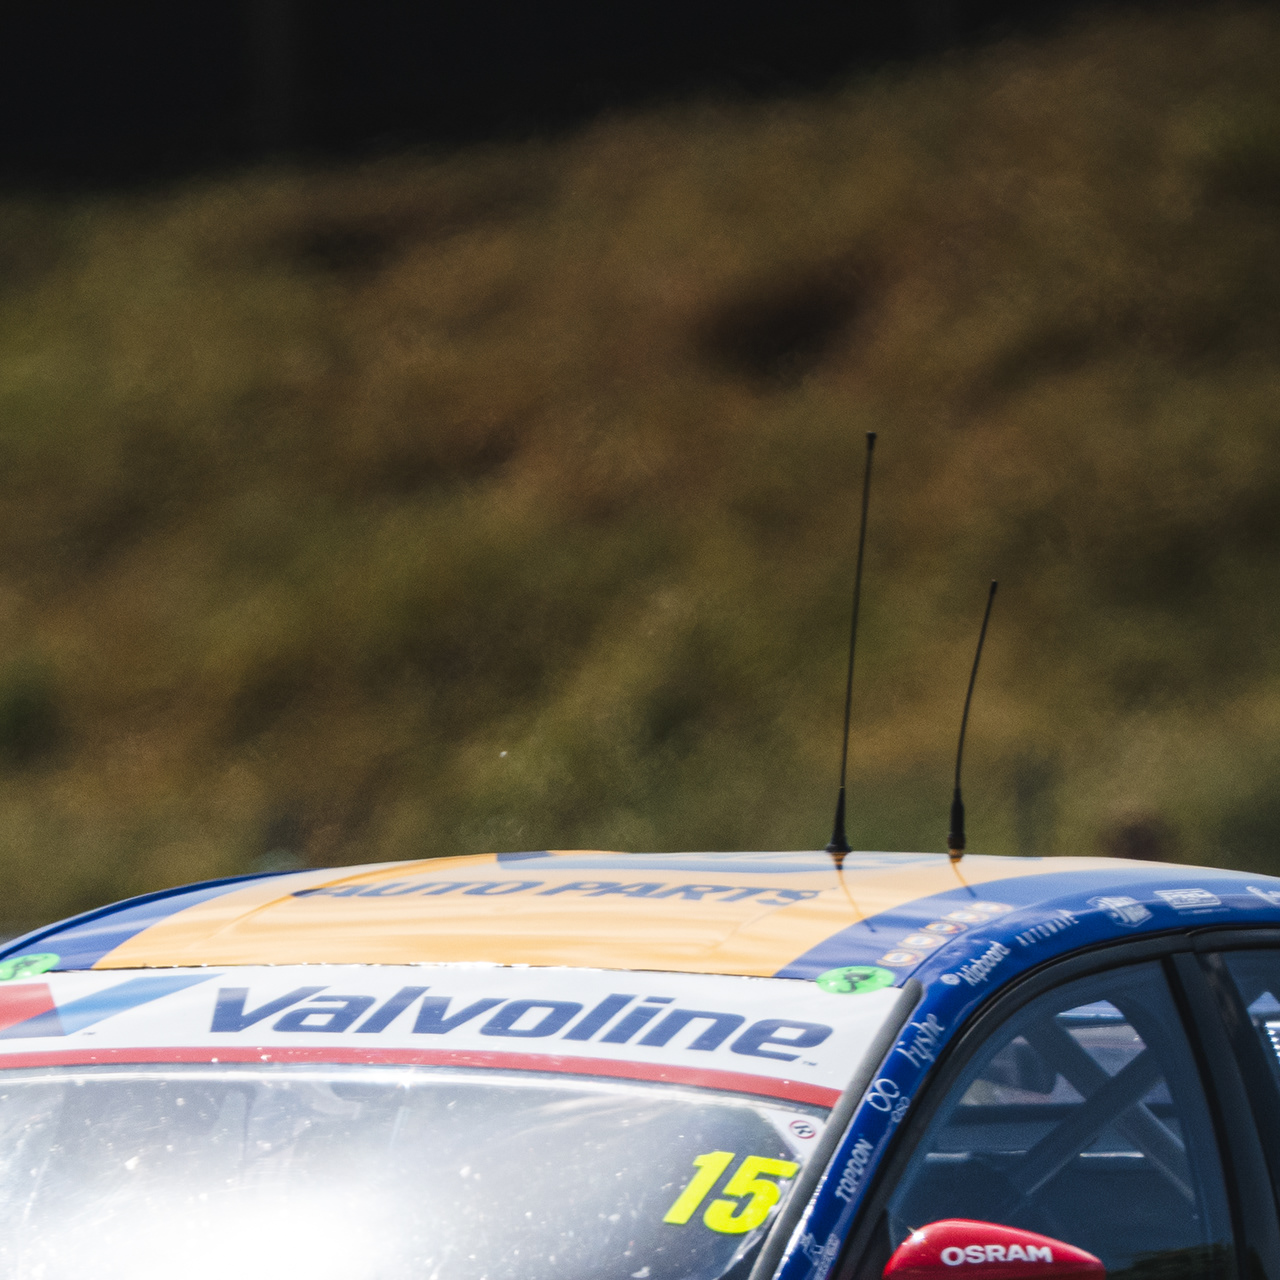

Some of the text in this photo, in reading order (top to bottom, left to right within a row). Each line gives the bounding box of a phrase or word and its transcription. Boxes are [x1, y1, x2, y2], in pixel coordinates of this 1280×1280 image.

[292, 880, 824, 907] AUTO PARTS
[210, 984, 832, 1063] Valvoline
[662, 1150, 799, 1235] 15
[940, 1243, 1053, 1267] OSRAM
